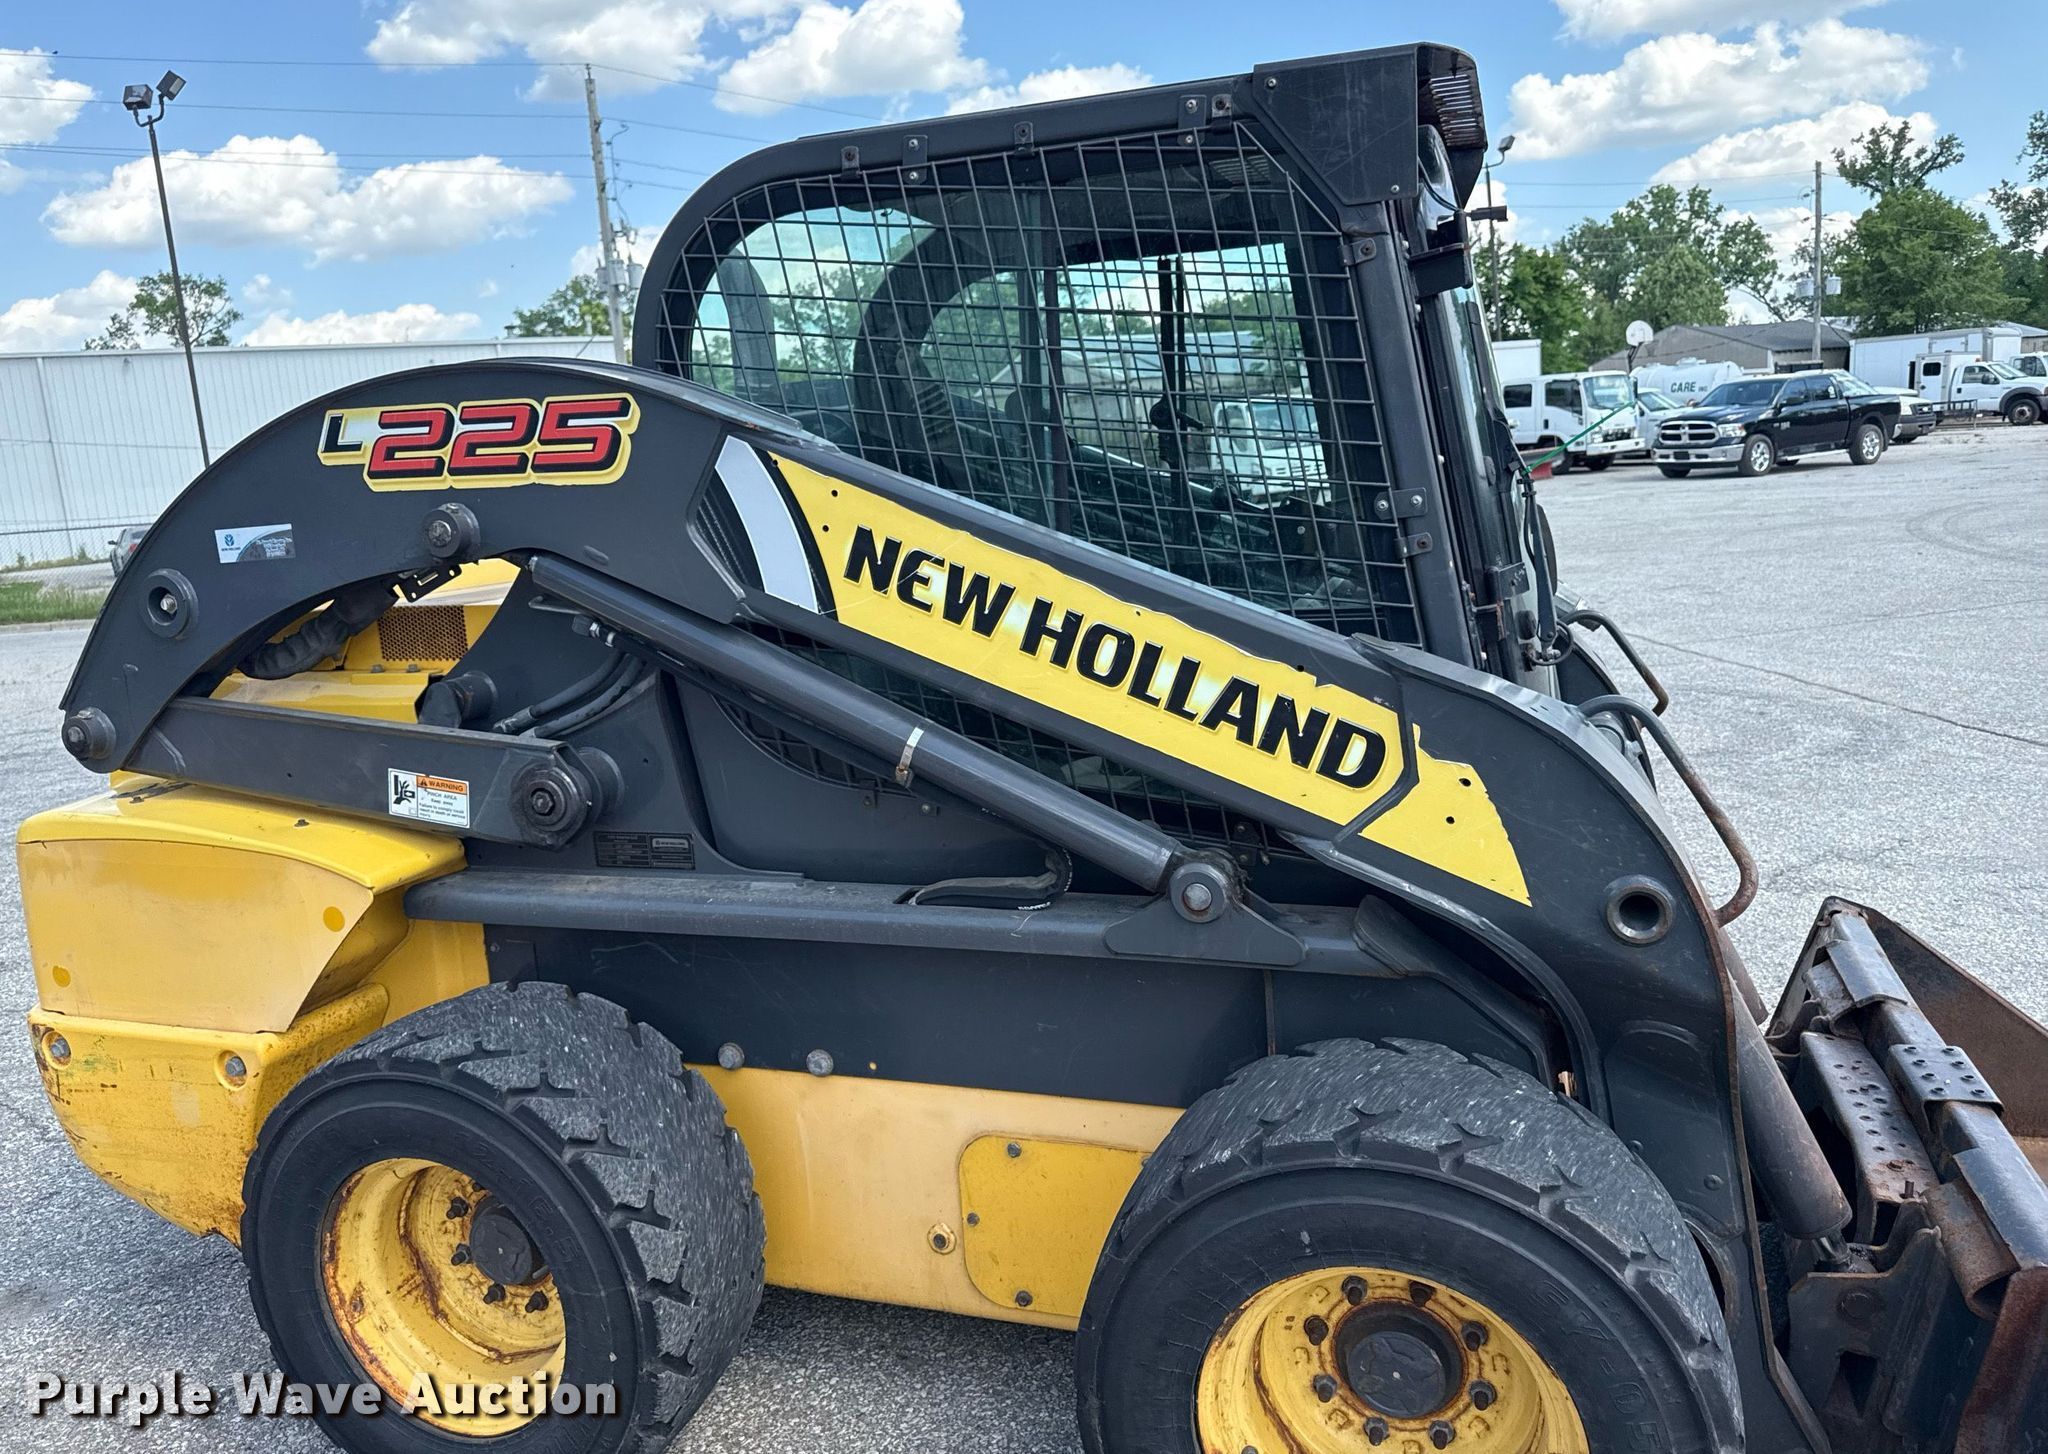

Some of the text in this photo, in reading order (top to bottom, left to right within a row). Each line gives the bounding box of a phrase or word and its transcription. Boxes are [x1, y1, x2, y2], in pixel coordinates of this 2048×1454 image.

[1670, 381, 1697, 393] CARE
[844, 524, 1388, 789] NEW HOLLAND
[428, 780, 464, 793] WARNING
